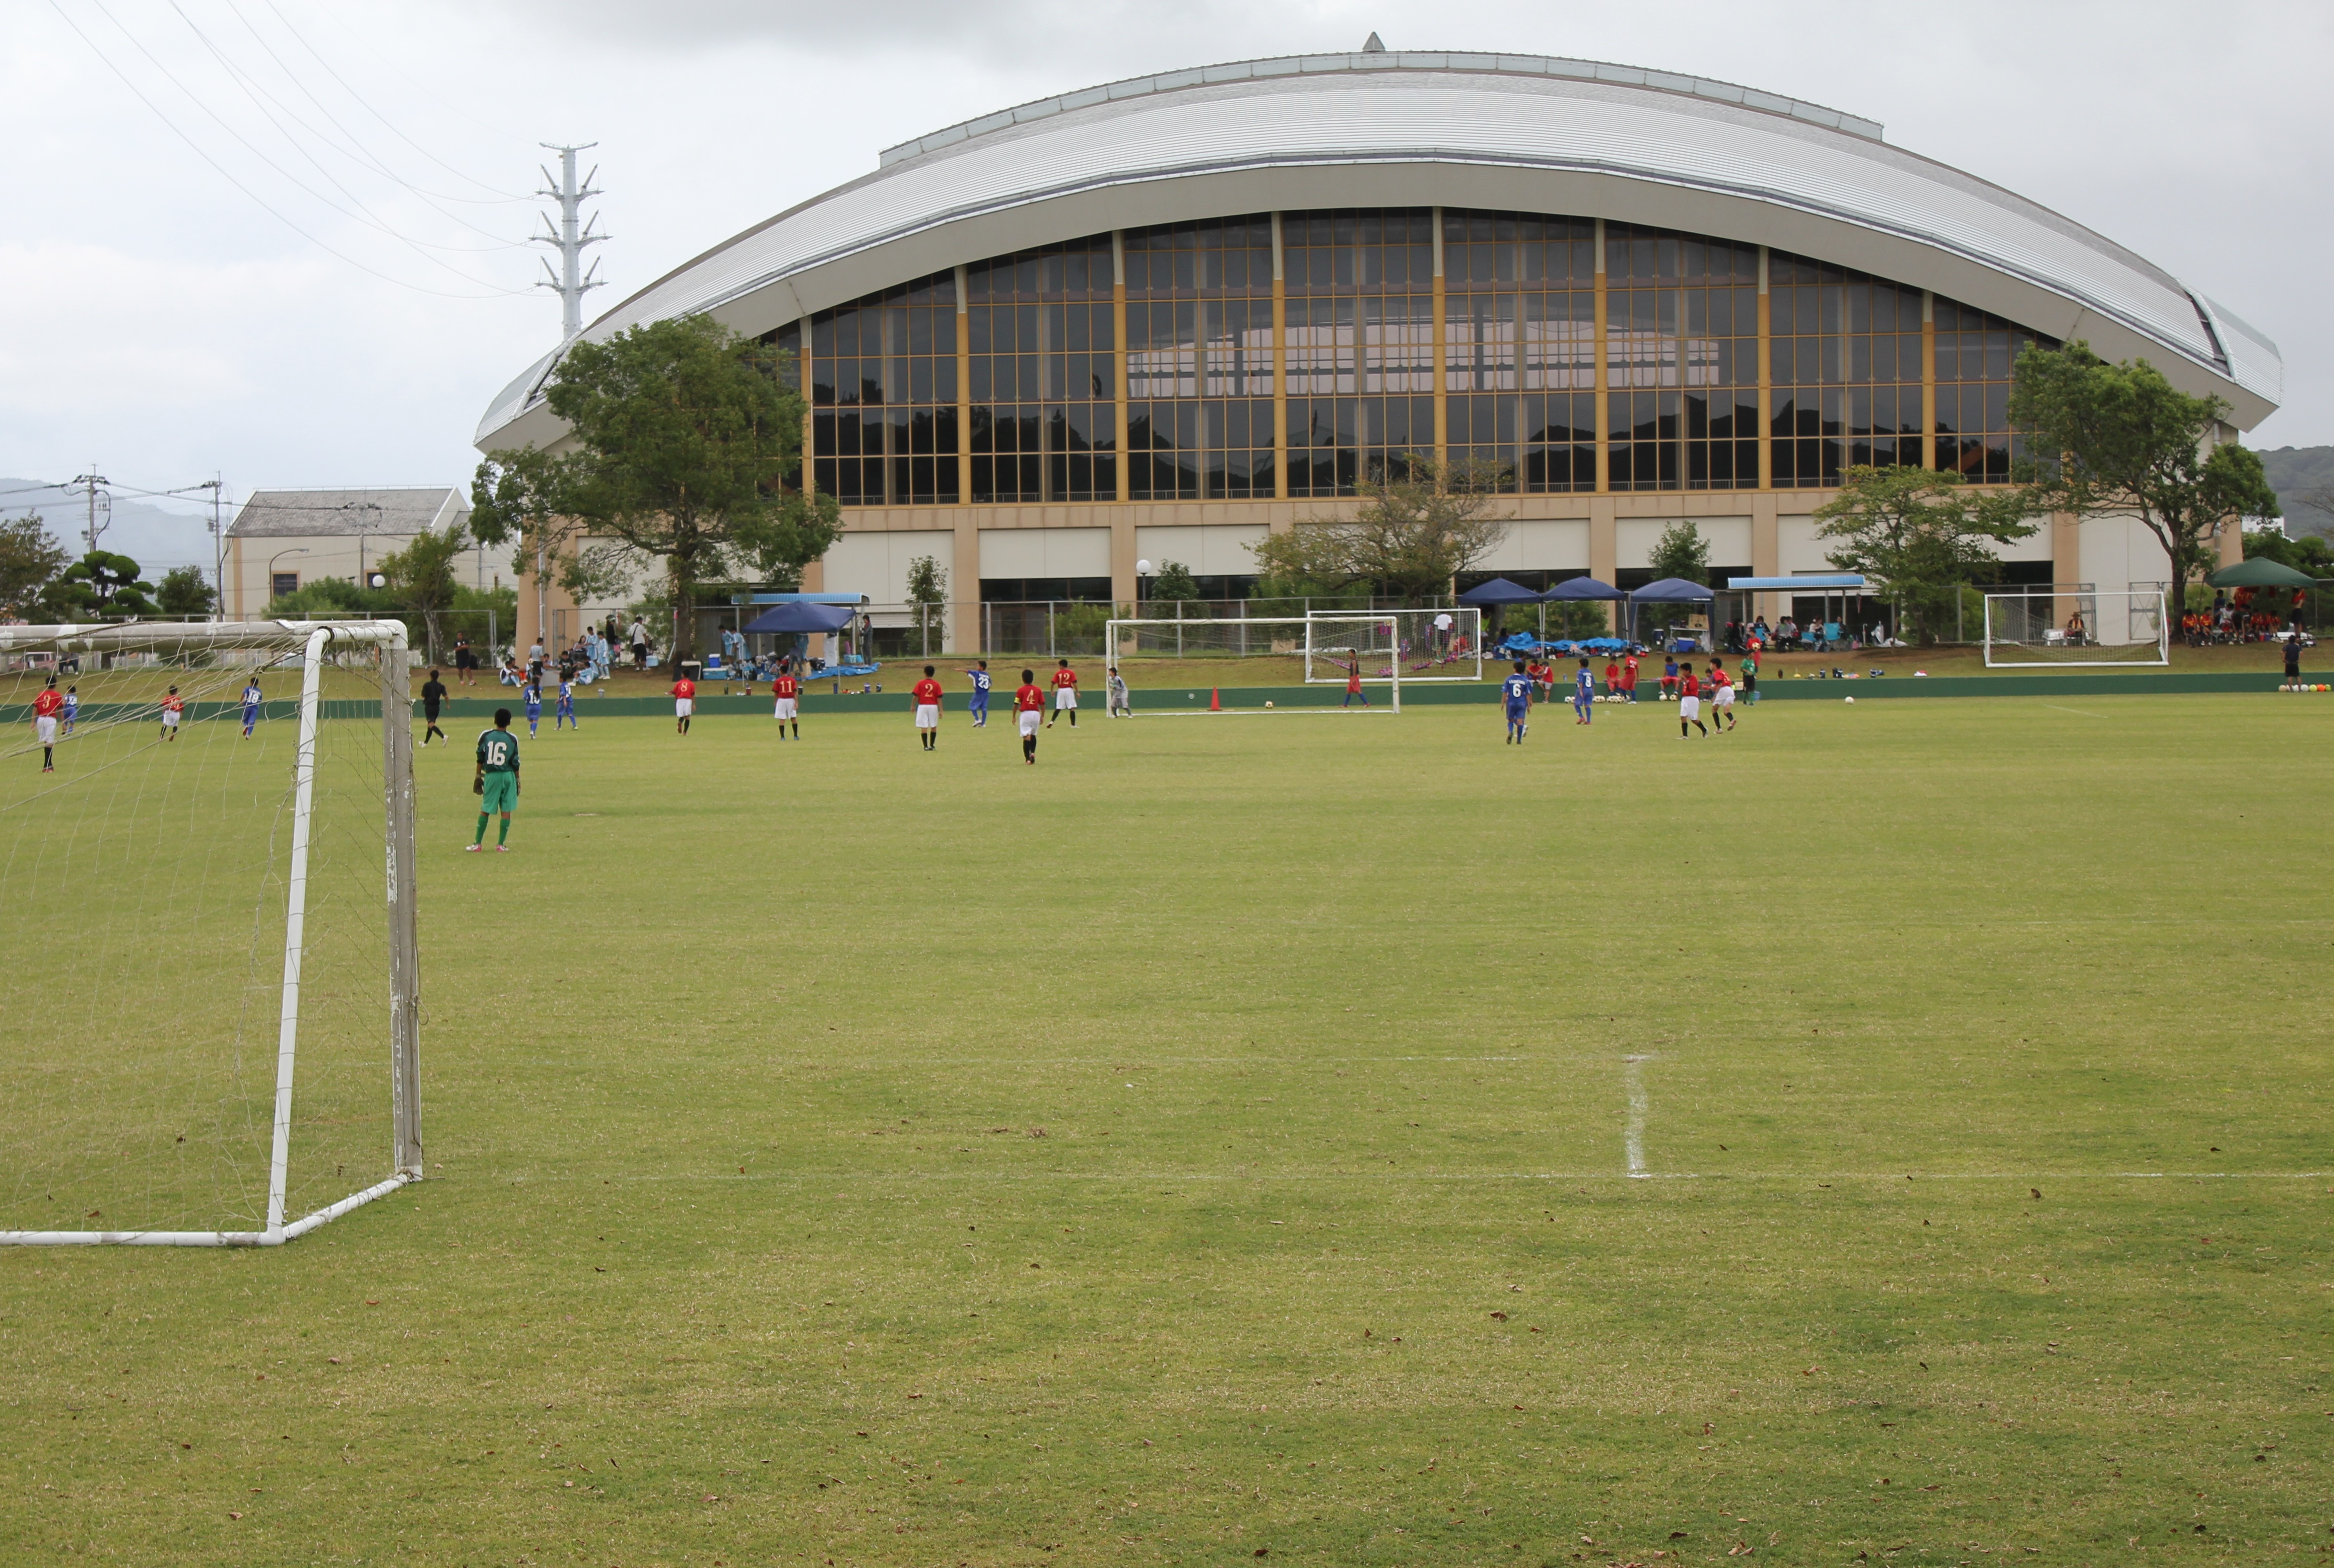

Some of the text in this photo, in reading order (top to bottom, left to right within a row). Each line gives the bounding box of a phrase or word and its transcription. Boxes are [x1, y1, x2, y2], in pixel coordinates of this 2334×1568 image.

[978, 677, 989, 689] 23
[1058, 673, 1070, 685] 12
[1585, 675, 1592, 688] 8
[681, 682, 688, 692] 8
[780, 680, 792, 693] 11
[924, 684, 933, 697] 2
[1512, 683, 1521, 698] 6
[42, 695, 51, 709] 3
[247, 692, 259, 704] 18
[1026, 689, 1035, 705] 4
[487, 741, 507, 766] 16
